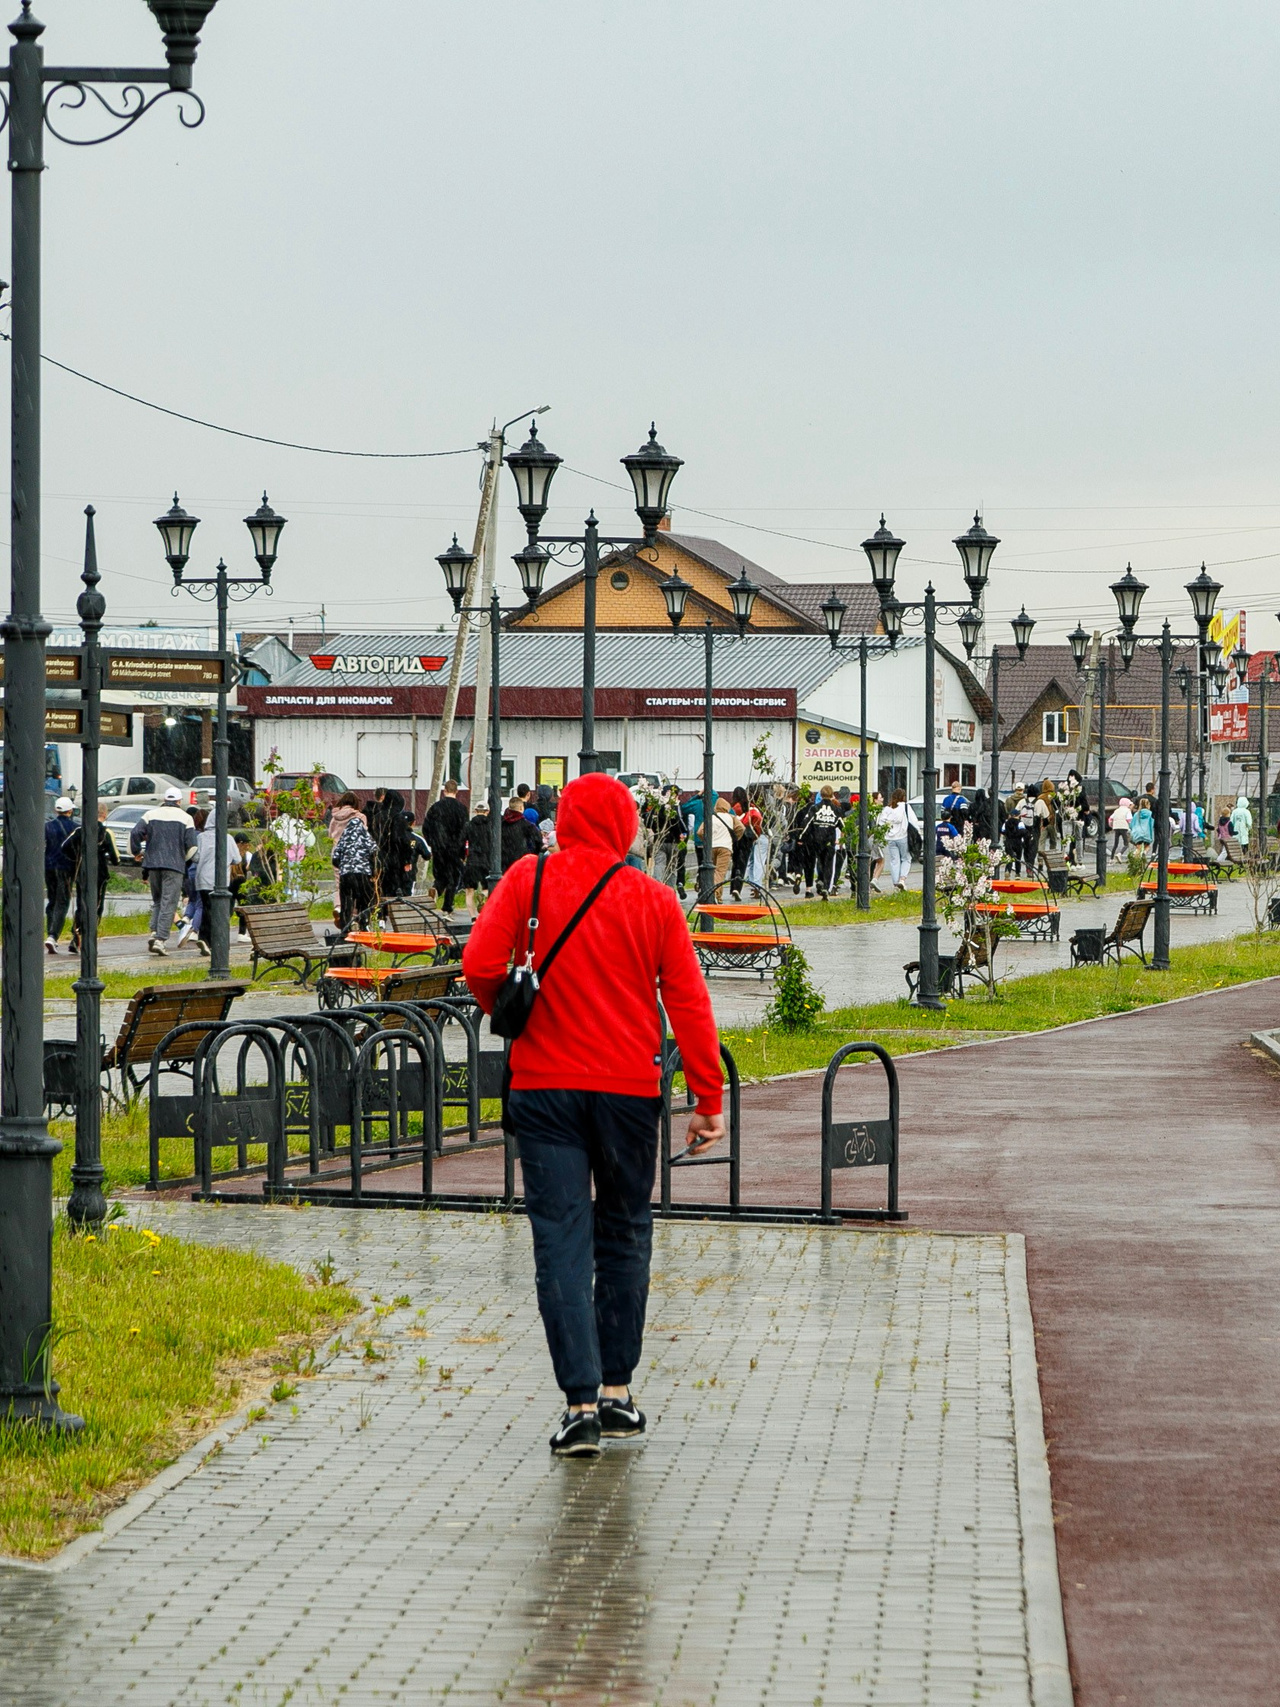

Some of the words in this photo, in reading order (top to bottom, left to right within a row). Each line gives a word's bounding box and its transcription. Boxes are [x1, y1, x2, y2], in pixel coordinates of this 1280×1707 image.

[45, 633, 200, 650] ИНМОНТАЖ
[157, 662, 174, 670] estate
[174, 663, 203, 671] warehouse
[331, 655, 426, 673] АВТОГИД
[265, 696, 314, 705] ЗАПЧАСТИ
[316, 696, 336, 706] ДЛЯ
[338, 696, 393, 705] ИНОМАРОК
[804, 748, 859, 757] ЗАПРАВК
[813, 761, 854, 772] АВТО
